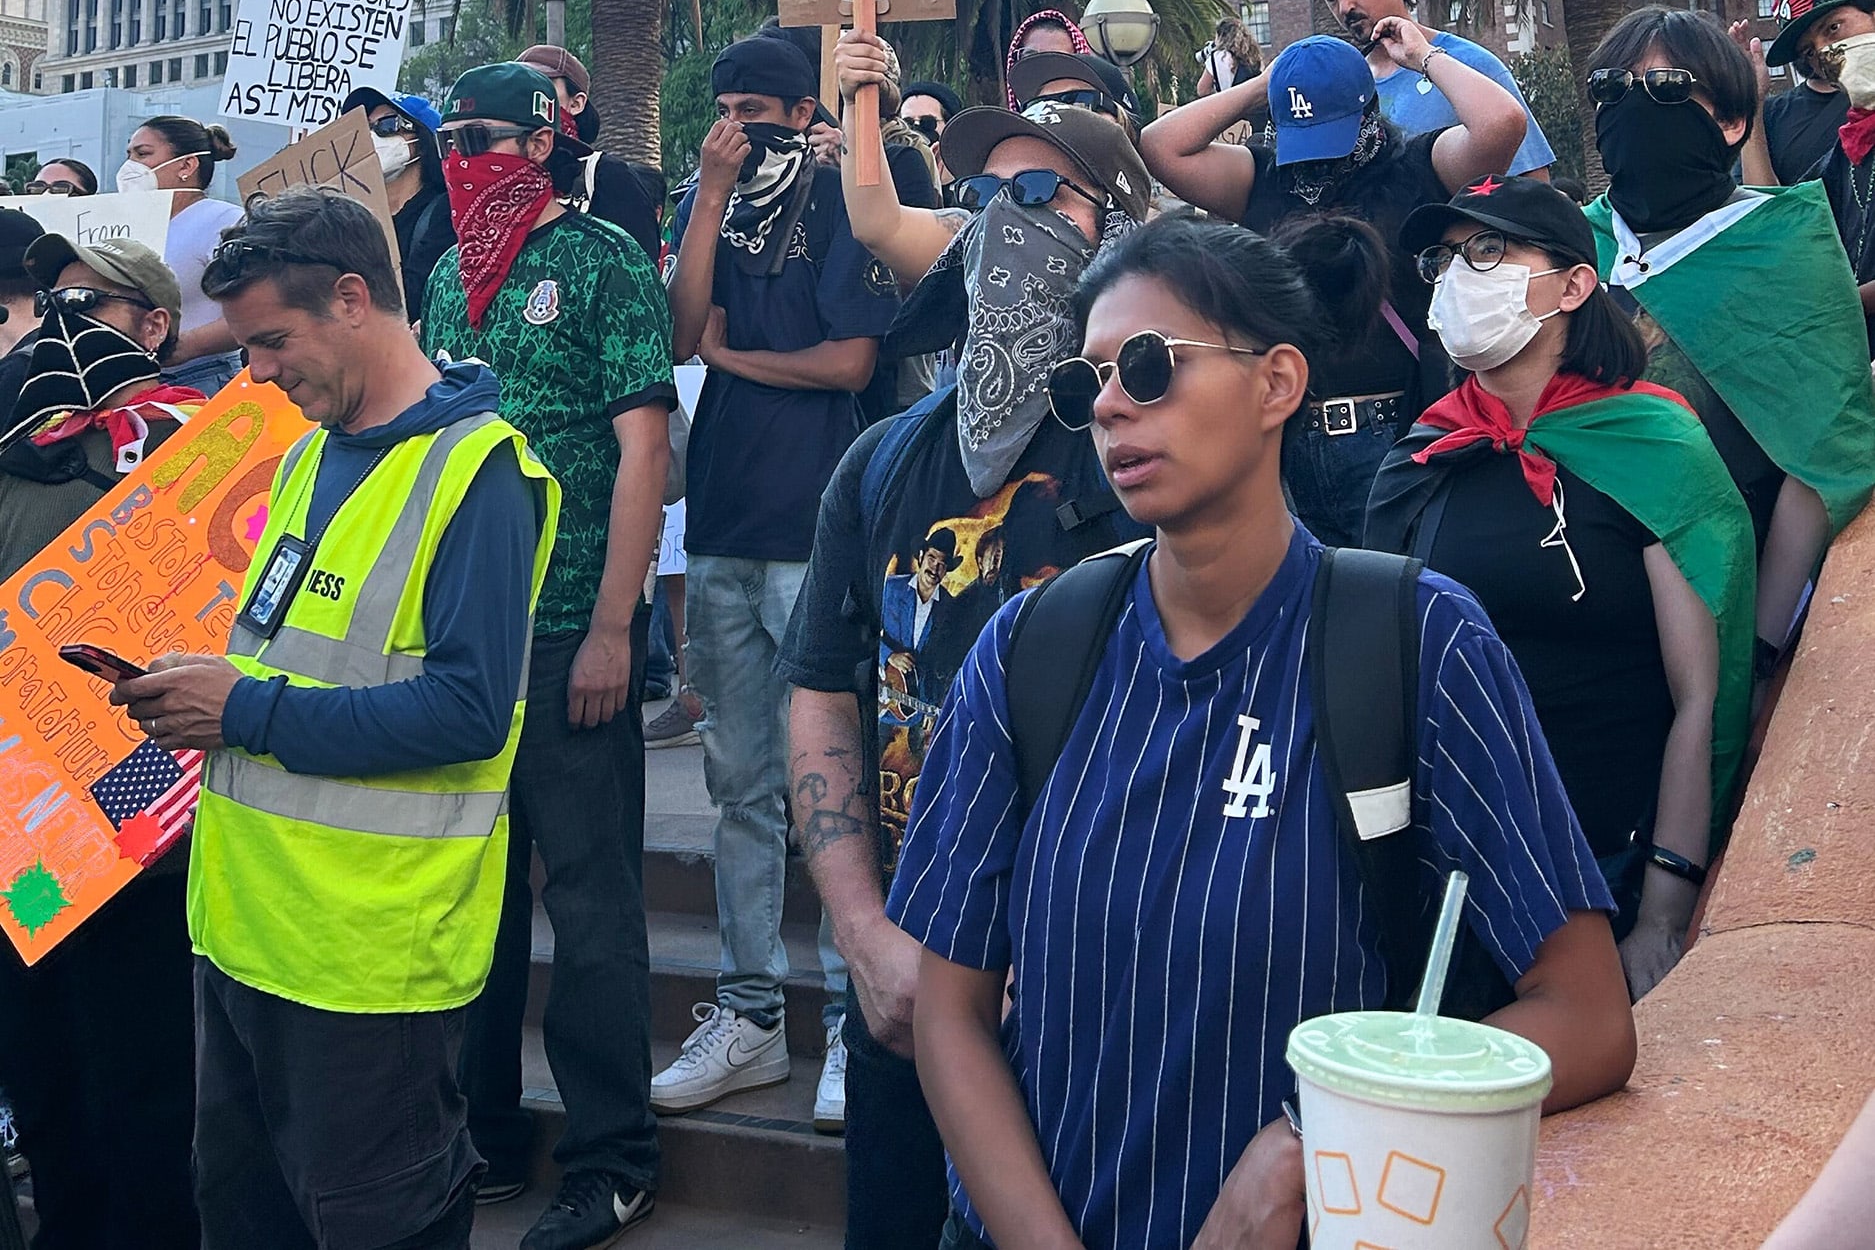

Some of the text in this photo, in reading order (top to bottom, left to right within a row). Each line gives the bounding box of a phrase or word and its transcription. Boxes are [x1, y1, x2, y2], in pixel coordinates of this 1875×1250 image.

[305, 0, 403, 40] EXISTEN
[232, 20, 380, 69] EL PUEBLO SE
[267, 59, 351, 94] LIBERA
[1287, 87, 1314, 119] LA
[77, 210, 130, 245] From
[306, 569, 345, 601] ESS
[195, 580, 236, 638] Te
[1221, 714, 1277, 819] LA
